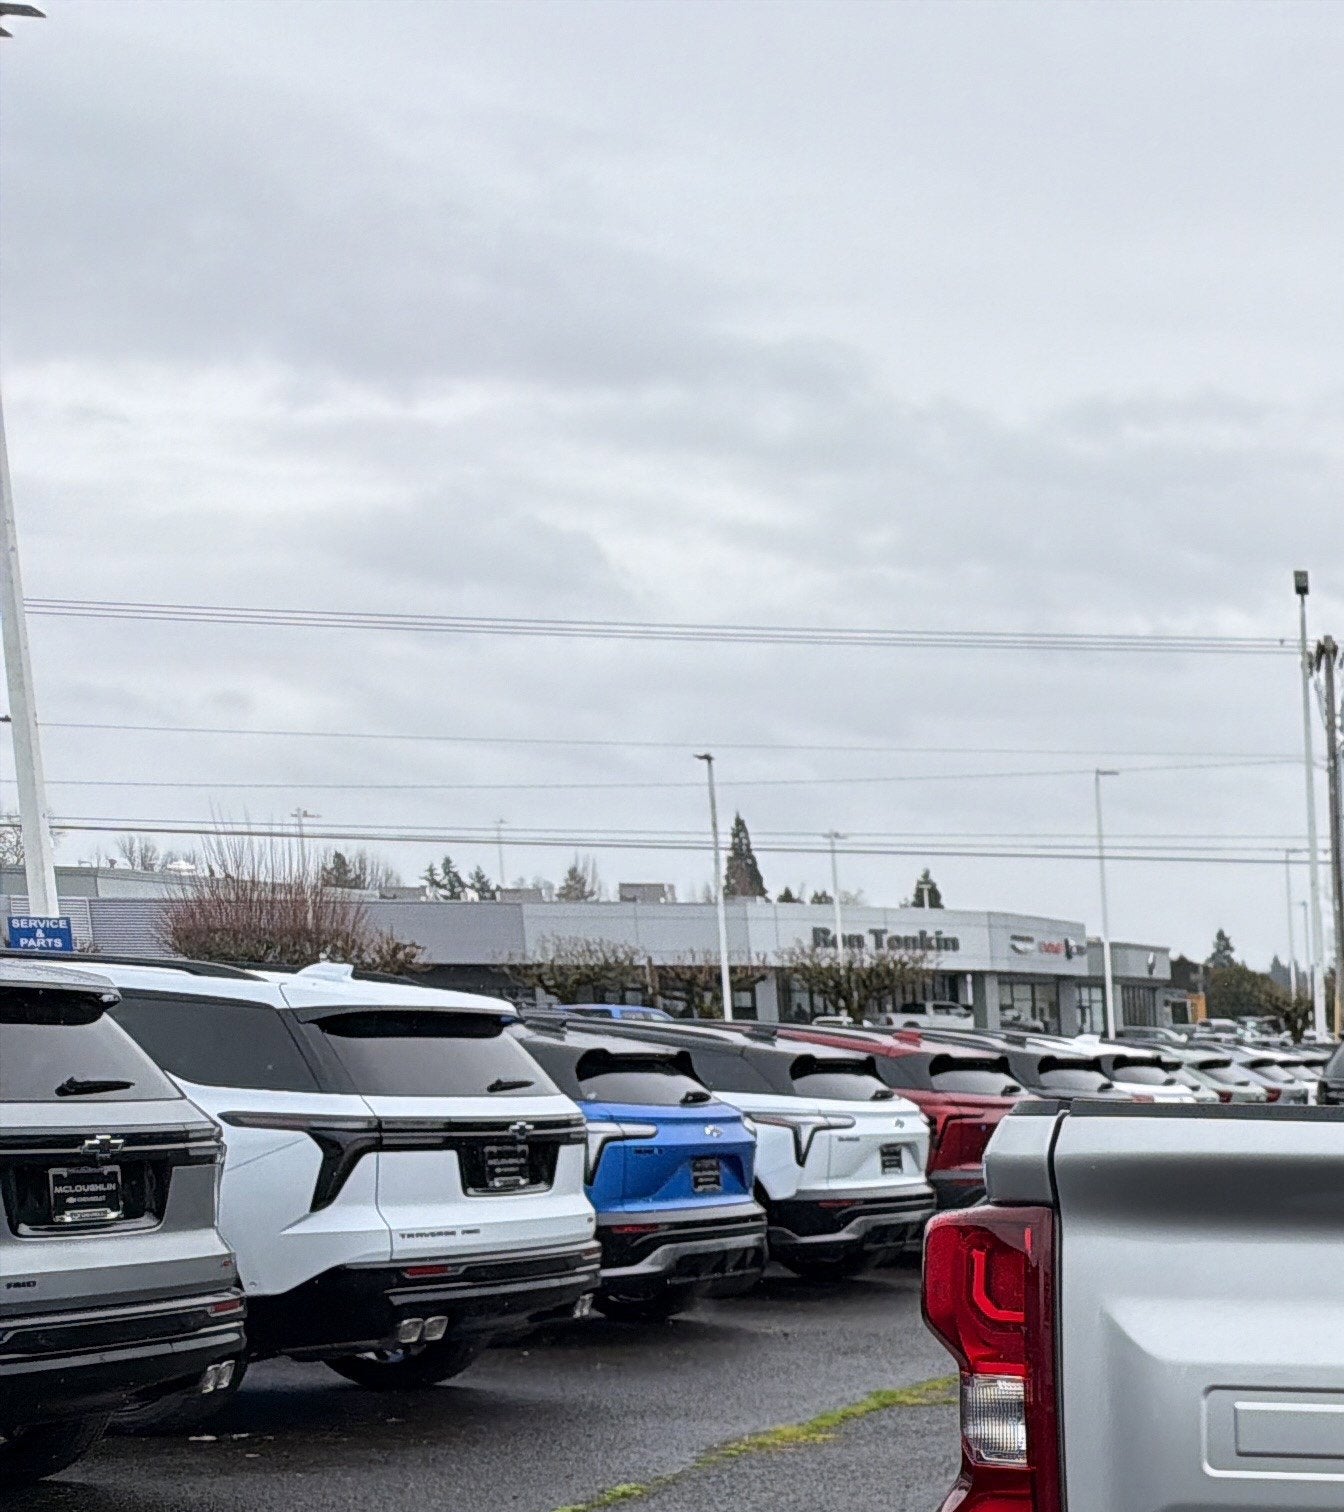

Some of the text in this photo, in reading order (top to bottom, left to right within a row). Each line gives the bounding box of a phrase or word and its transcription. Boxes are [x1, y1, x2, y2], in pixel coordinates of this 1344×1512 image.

[11, 919, 68, 929] SERVICE
[36, 928, 45, 937] &
[19, 937, 63, 948] PARTS
[867, 928, 960, 951] Tonkin
[53, 1182, 117, 1194] MCLOUGHLIN
